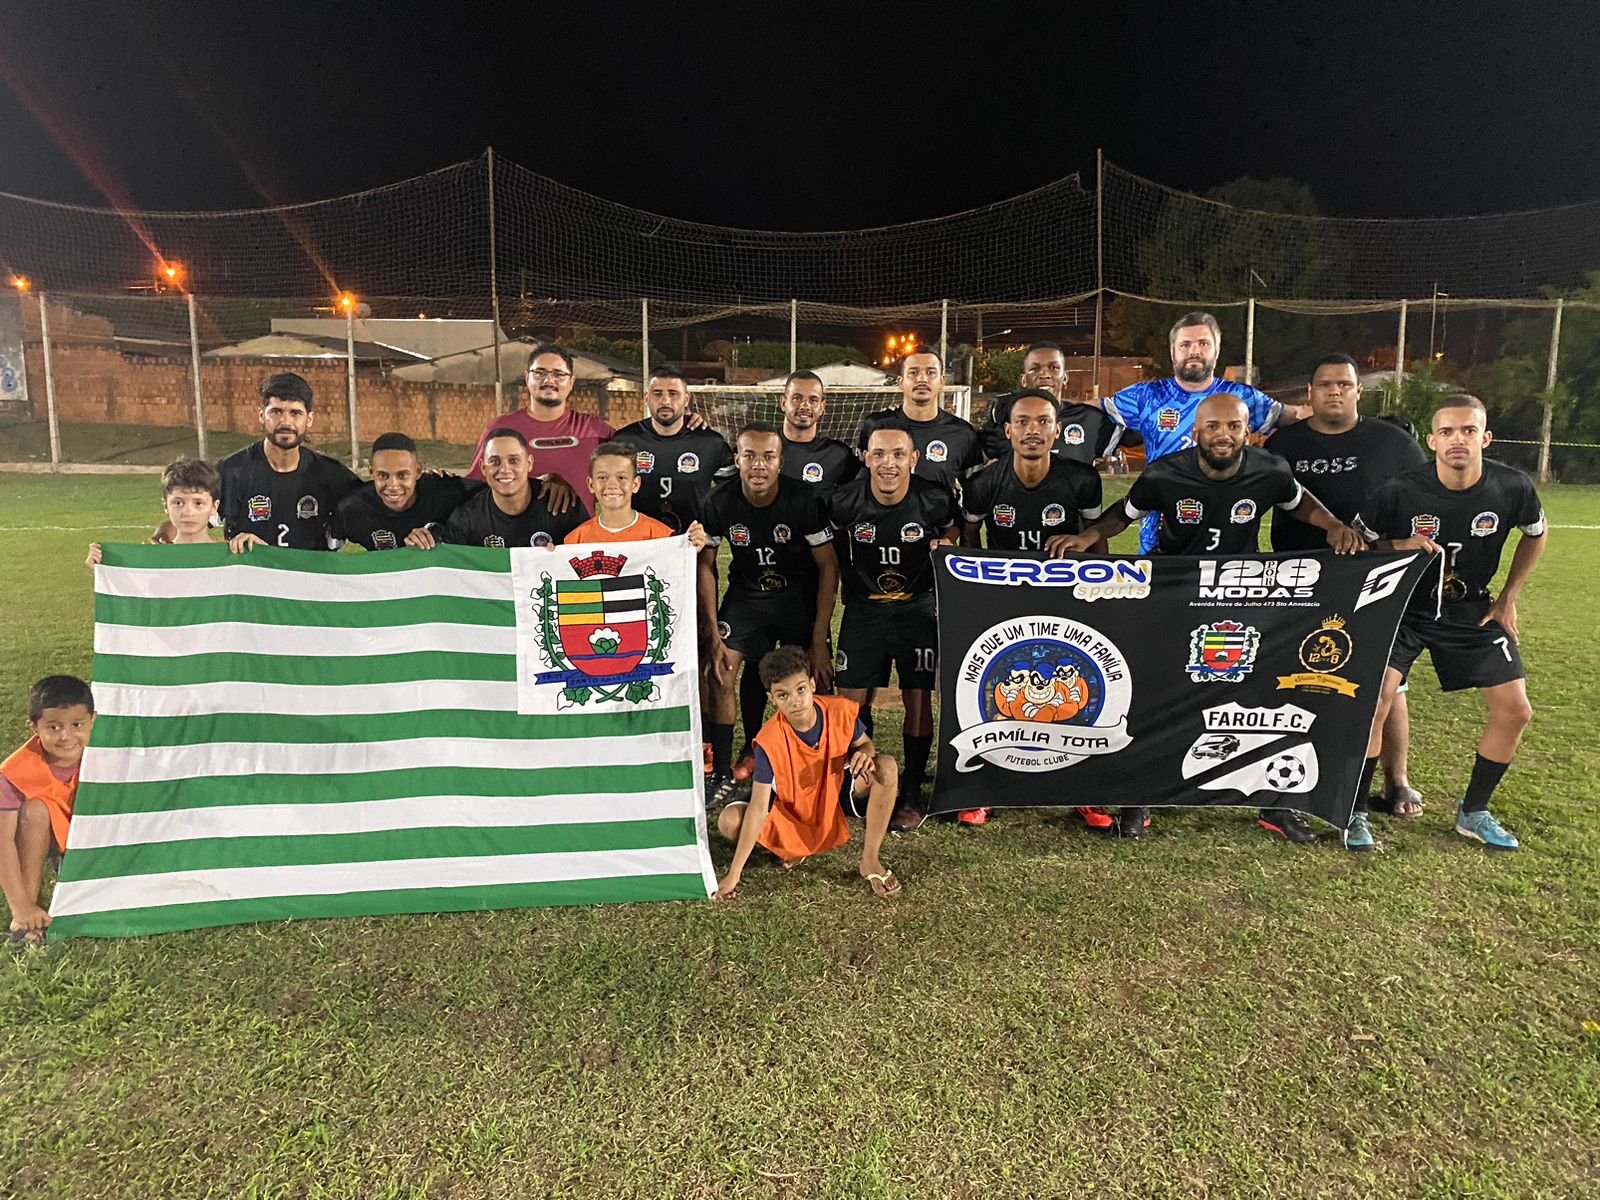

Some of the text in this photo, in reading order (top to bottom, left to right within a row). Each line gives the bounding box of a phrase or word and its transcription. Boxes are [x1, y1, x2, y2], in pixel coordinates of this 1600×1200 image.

[1295, 456, 1358, 474] BOSS
[660, 477, 672, 498] 9
[278, 524, 290, 547] 2
[1018, 530, 1041, 550] 14
[1206, 528, 1221, 551] 3
[755, 547, 776, 566] 12
[878, 547, 900, 565] 10
[1447, 542, 1463, 567] 7
[950, 556, 1149, 584] GERSON
[1077, 583, 1147, 599] sports
[1199, 587, 1314, 600] MODAS
[965, 622, 1123, 683] MAIS QUE UM TIME UMA FAMÍLIA
[1493, 636, 1512, 662] 7
[914, 648, 935, 672] 10
[1208, 711, 1307, 729] FAROL F.C.
[972, 728, 1109, 748] FAMÍLIA TOTA
[1005, 754, 1069, 766] FUTEBOL CLUBE
